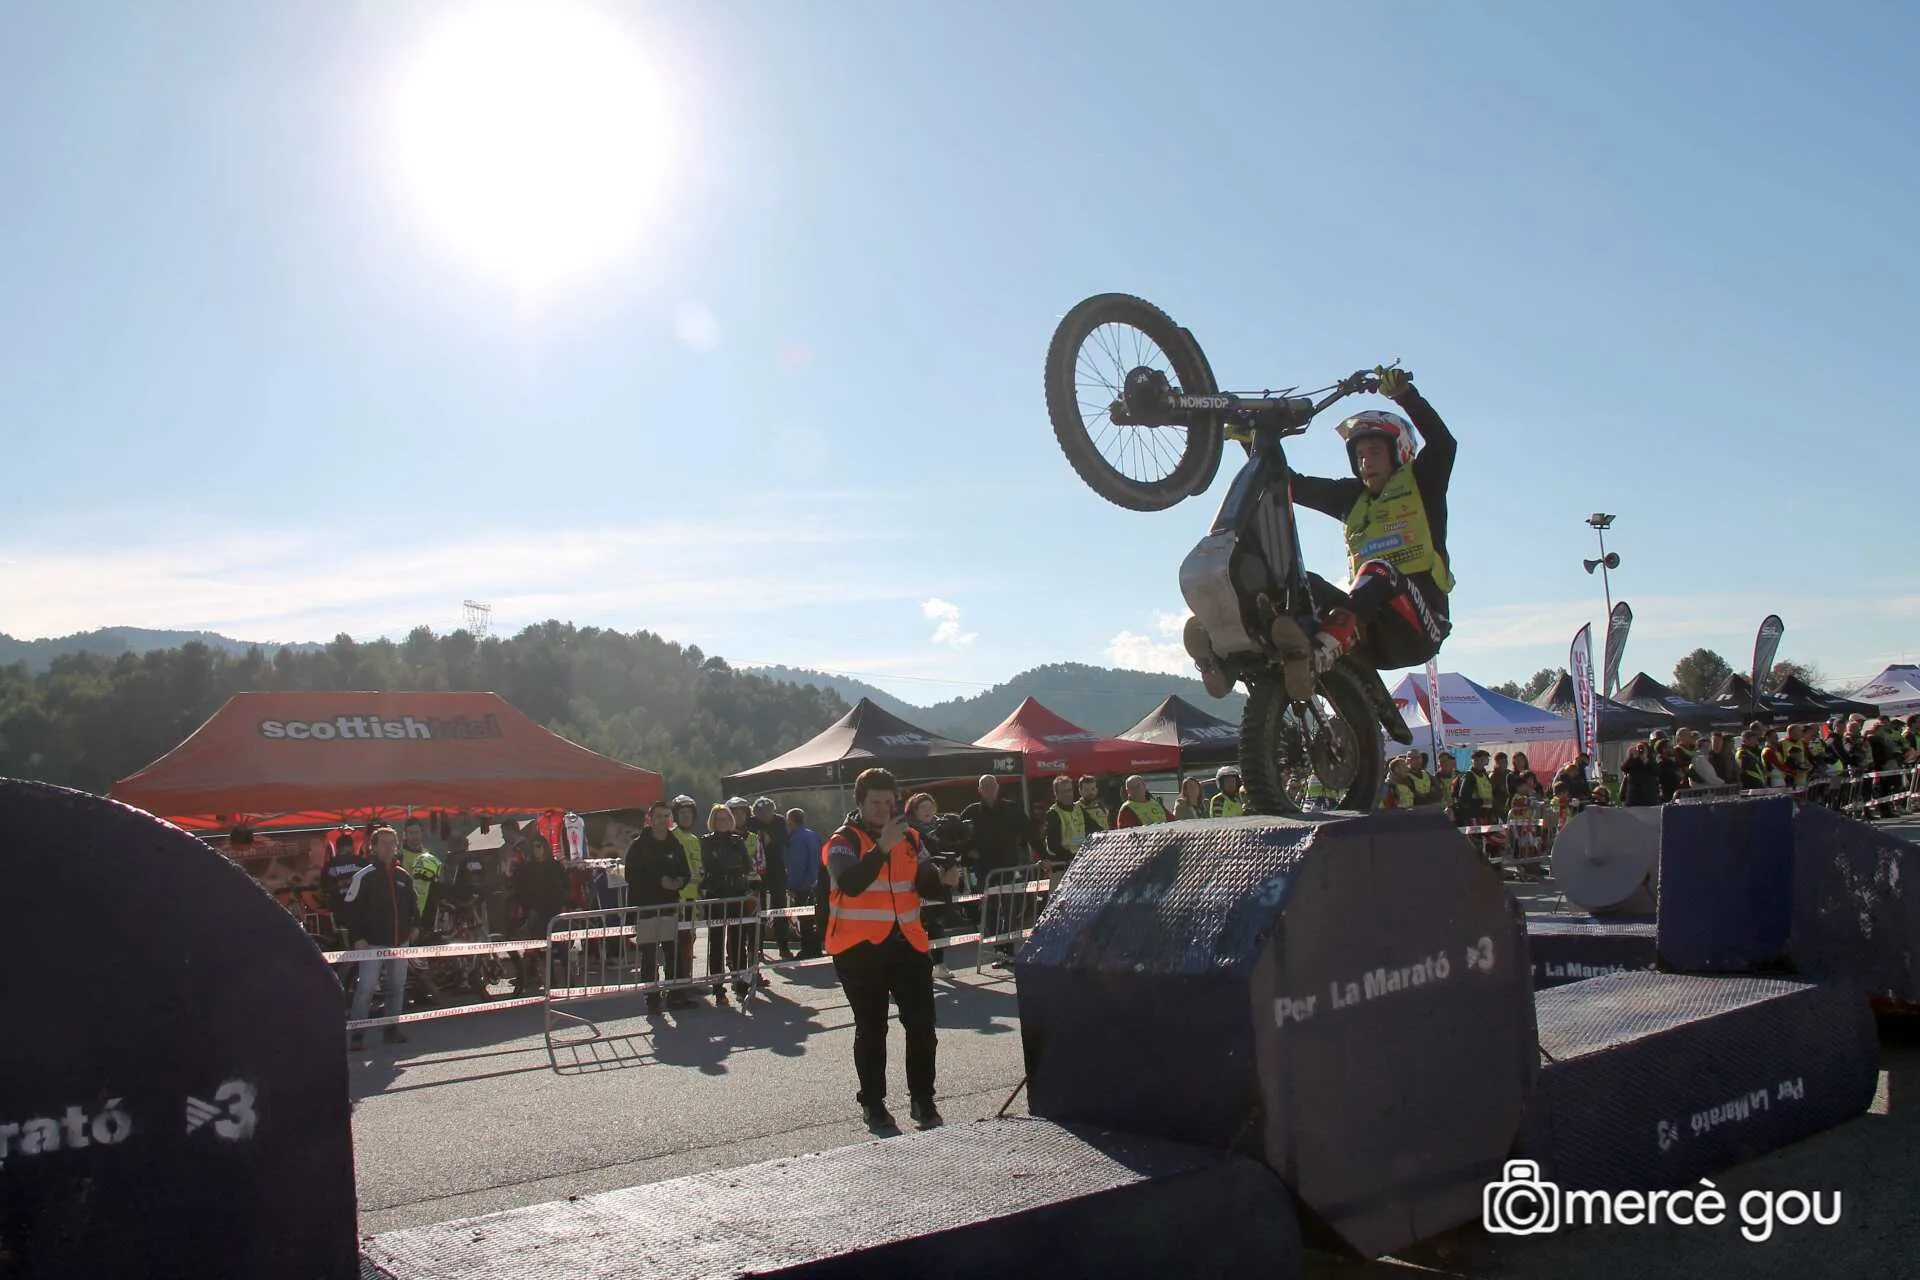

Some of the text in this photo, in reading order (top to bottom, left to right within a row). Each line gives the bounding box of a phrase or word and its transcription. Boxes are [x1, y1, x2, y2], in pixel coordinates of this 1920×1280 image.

[1180, 397, 1229, 408] NONSTOP
[1407, 577, 1441, 642] NONSTOP
[1274, 993, 1317, 1027] Per
[1330, 980, 1360, 1010] La
[1363, 951, 1450, 1000] Marató
[0, 1078, 257, 1158] rató 3
